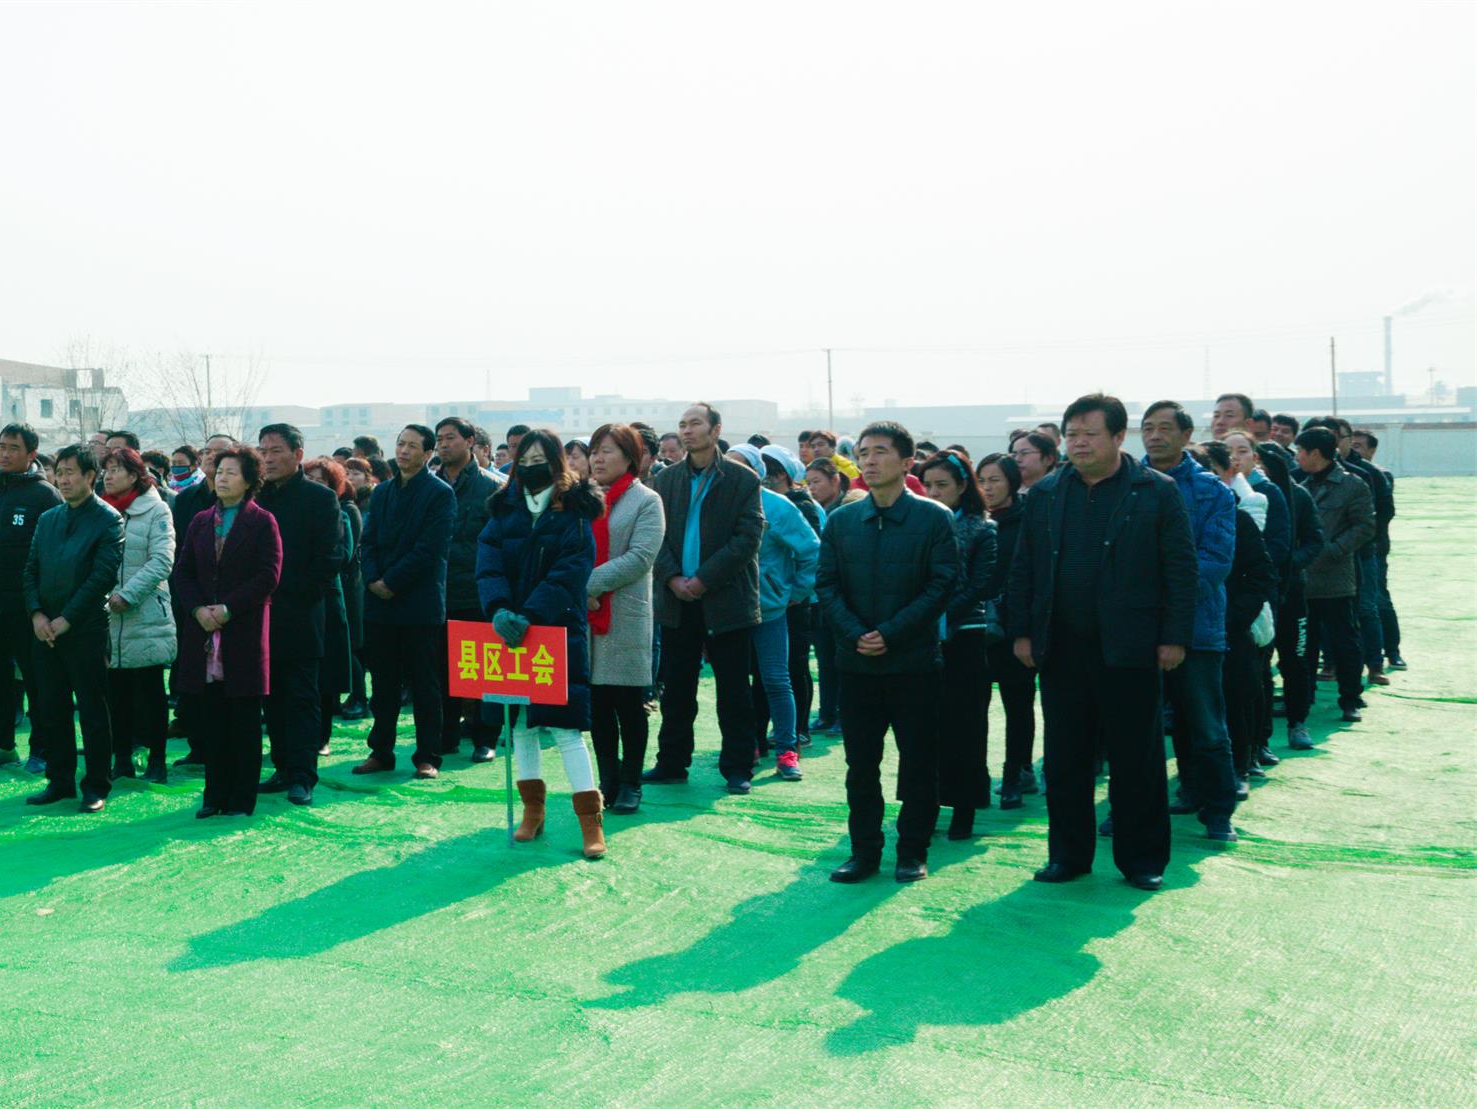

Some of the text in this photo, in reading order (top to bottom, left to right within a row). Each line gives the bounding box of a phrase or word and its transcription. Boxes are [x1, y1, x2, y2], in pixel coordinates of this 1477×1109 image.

[13, 514, 25, 526] 35
[457, 640, 555, 686] 县区工会
